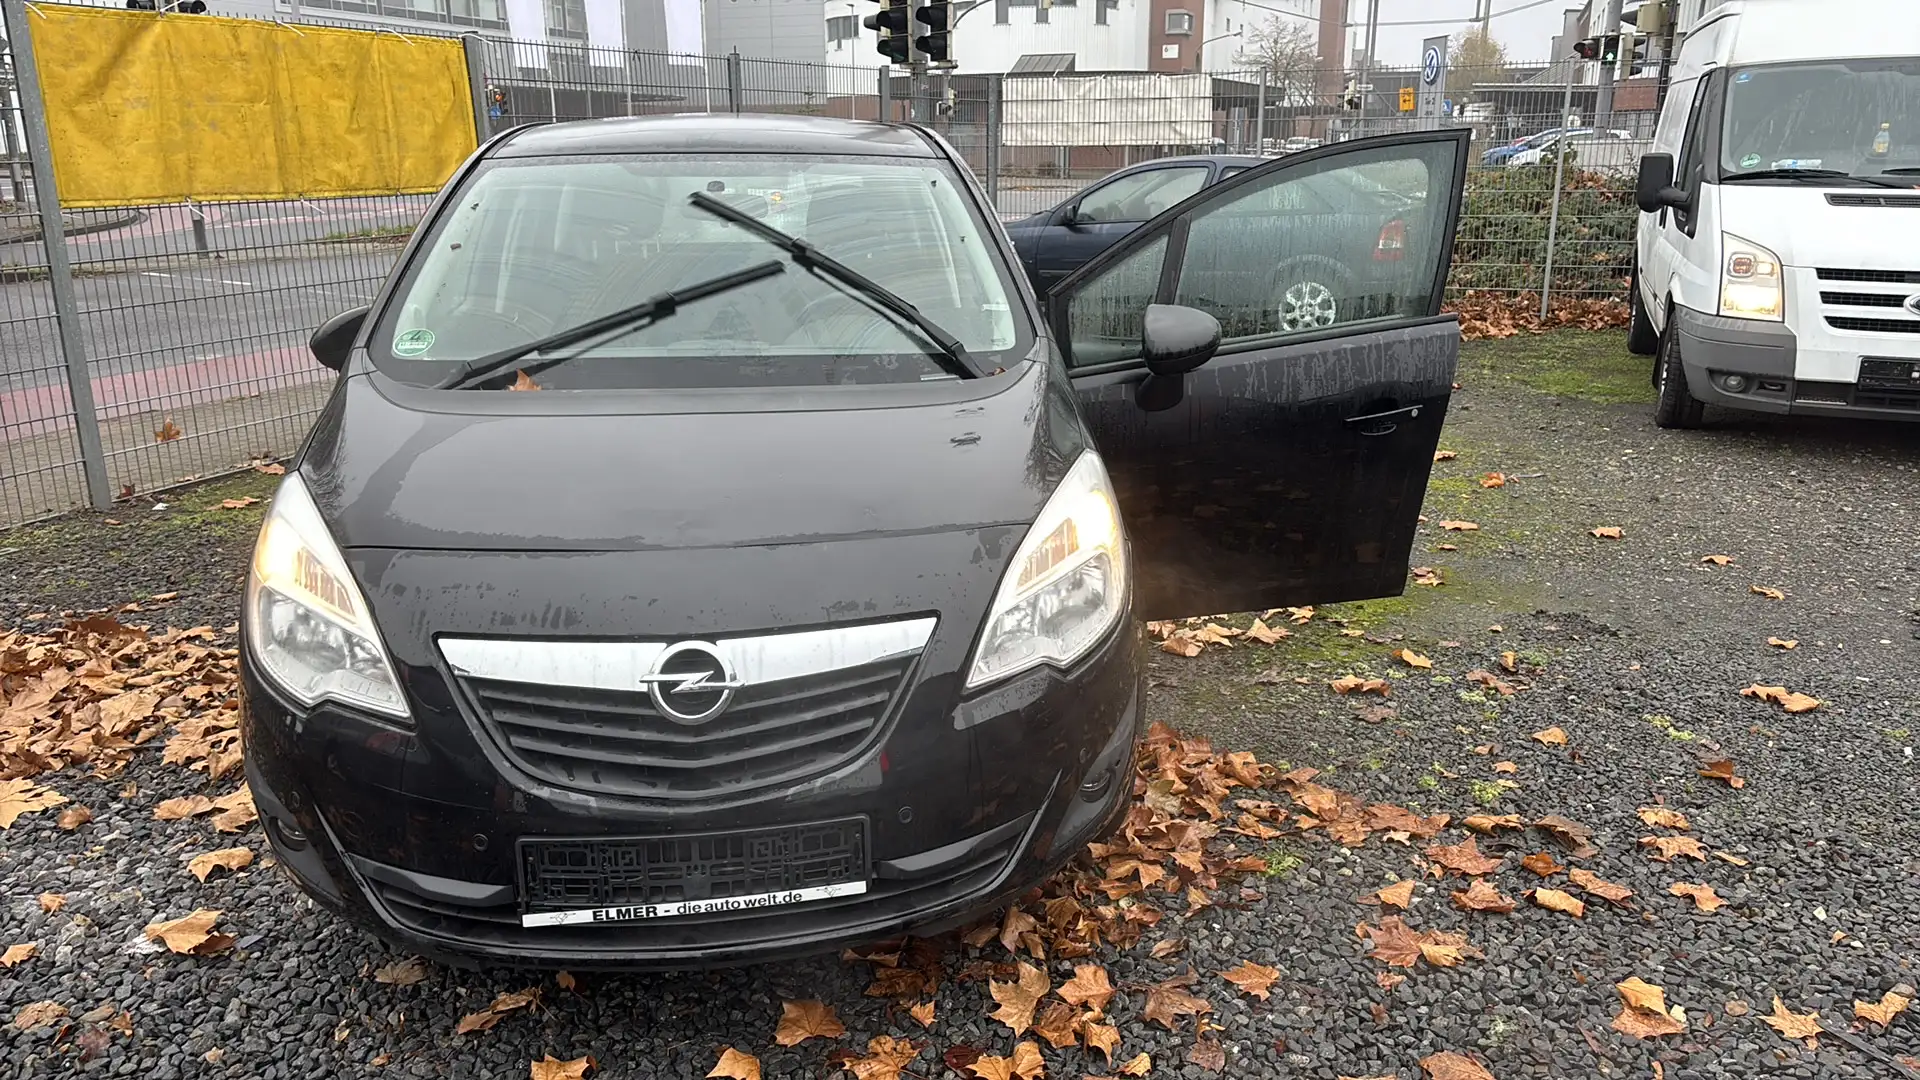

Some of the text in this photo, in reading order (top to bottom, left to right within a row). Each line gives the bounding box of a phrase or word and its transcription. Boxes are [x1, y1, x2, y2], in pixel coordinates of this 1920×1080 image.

[409, 330, 421, 342] 4
[592, 905, 658, 921] ELMER
[676, 902, 702, 915] die
[704, 899, 741, 912] auto
[743, 891, 803, 908] welt.de
